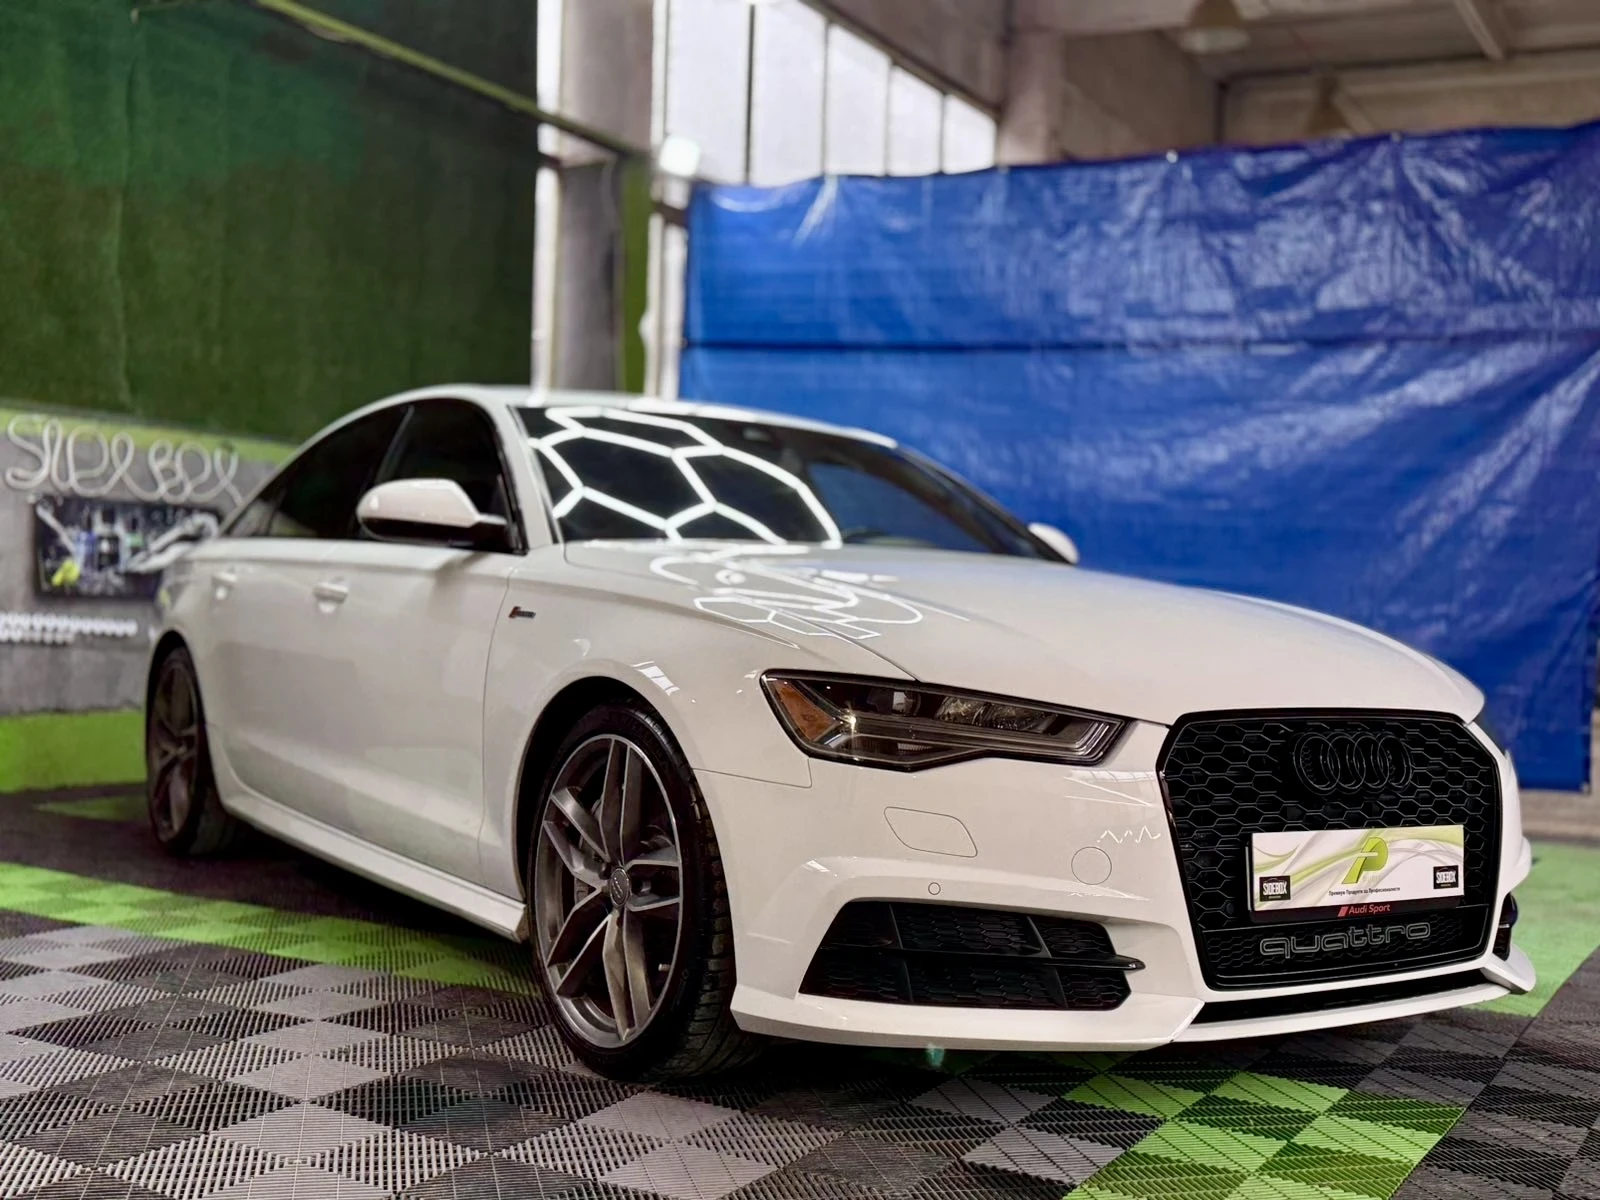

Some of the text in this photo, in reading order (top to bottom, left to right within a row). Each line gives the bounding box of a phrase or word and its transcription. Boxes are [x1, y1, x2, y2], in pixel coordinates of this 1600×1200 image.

[1436, 870, 1457, 885] SIDEBOX
[1262, 880, 1288, 896] SIDEBOX
[1348, 903, 1391, 914] Audi Sport
[1260, 922, 1431, 959] quattro
